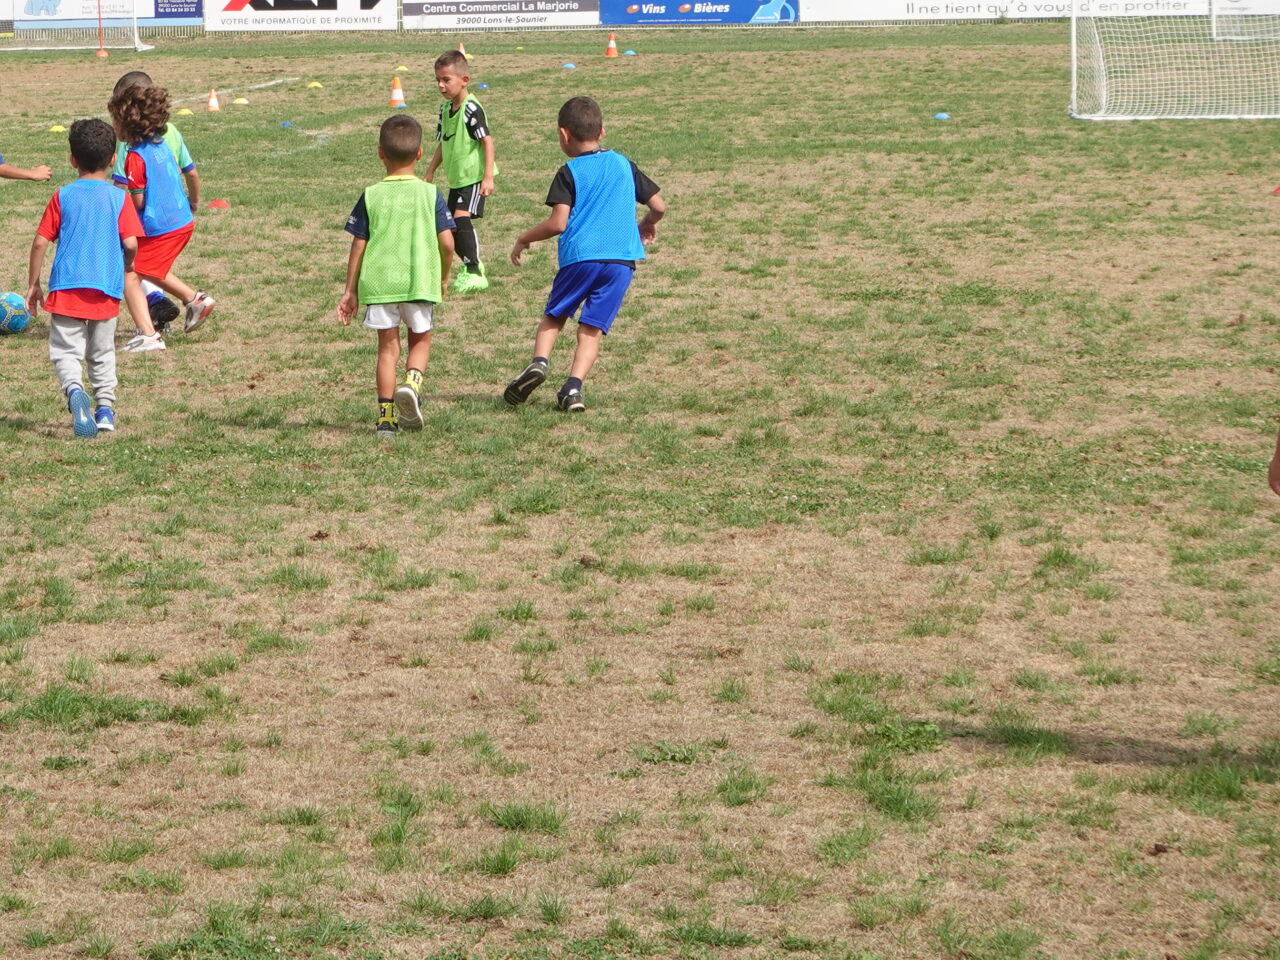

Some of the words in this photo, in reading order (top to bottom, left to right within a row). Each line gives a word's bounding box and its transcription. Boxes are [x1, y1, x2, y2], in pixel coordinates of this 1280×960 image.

[422, 3, 457, 13] Centre
[459, 2, 520, 12] Commercial
[522, 2, 535, 11] La
[537, 0, 579, 12] Marjorie
[641, 3, 666, 14] Vins
[694, 2, 730, 13] Bières
[906, 2, 915, 14] Il
[919, 4, 939, 14] ne
[945, 2, 981, 14] tient
[1035, 2, 1073, 13] vous
[1124, 0, 1189, 15] profiter
[252, 17, 317, 25] INFORMATIQUE
[456, 16, 482, 24] 39000
[483, 15, 547, 24] Lons-le-Saunier
